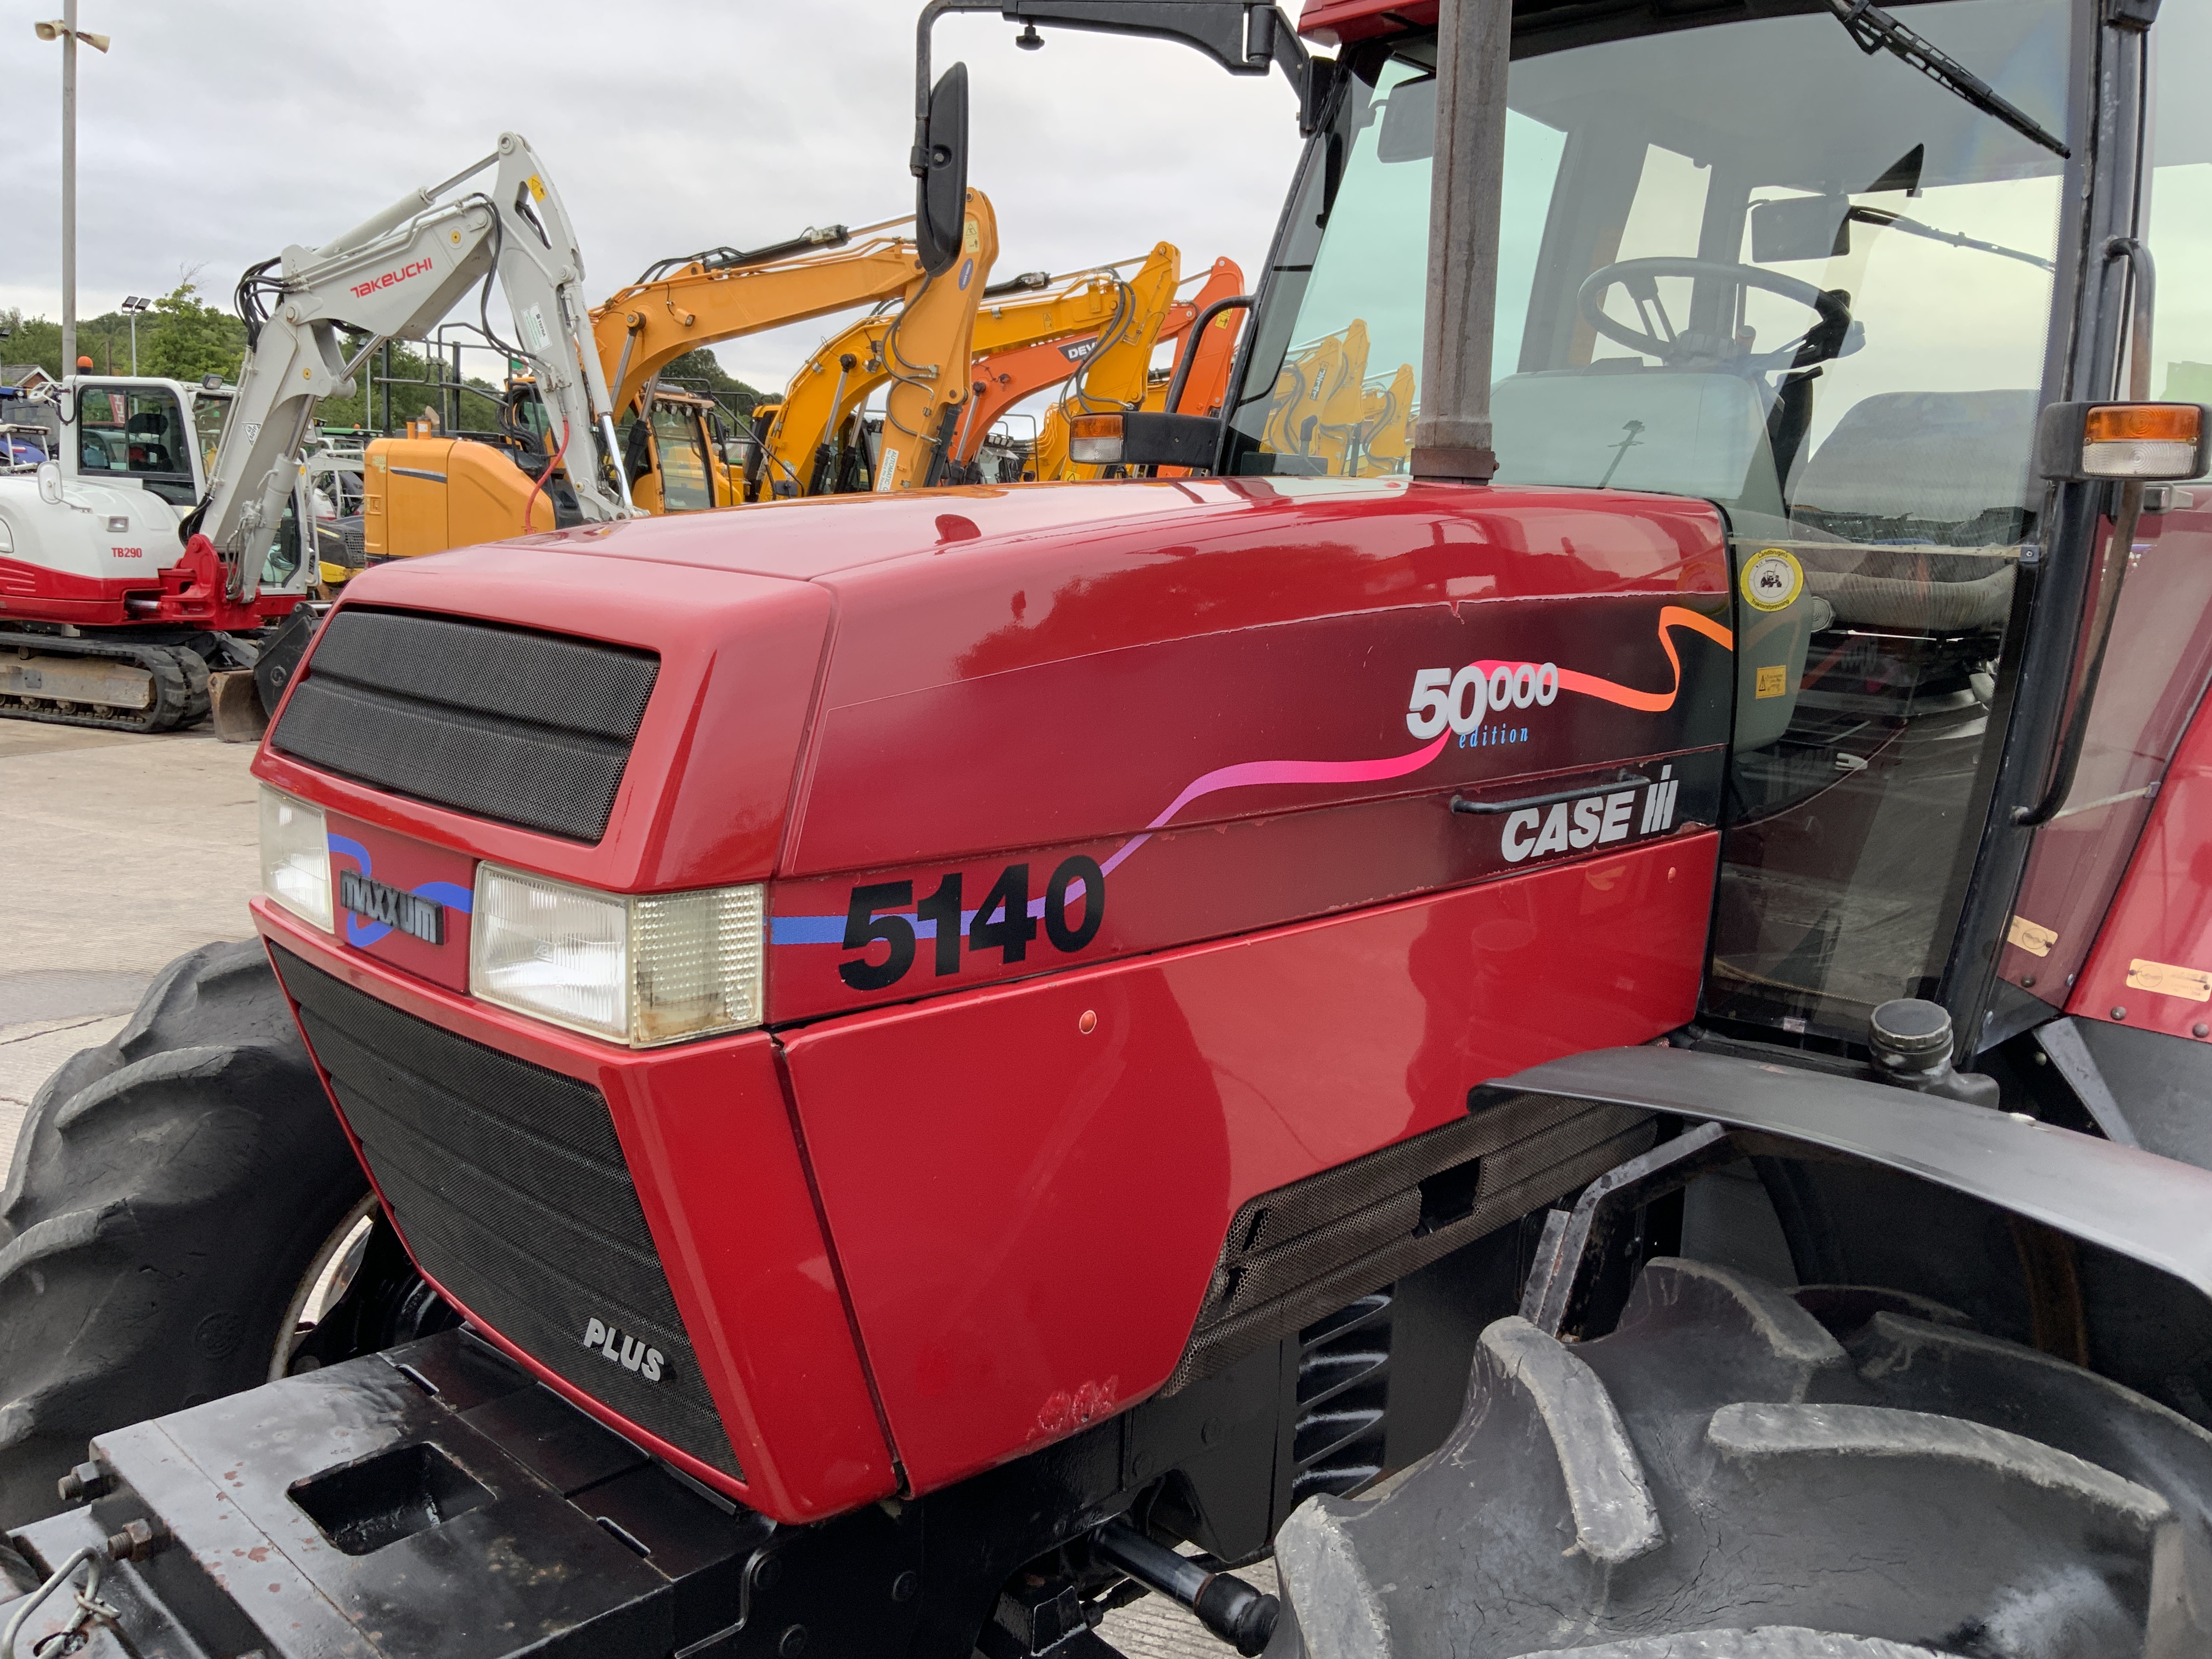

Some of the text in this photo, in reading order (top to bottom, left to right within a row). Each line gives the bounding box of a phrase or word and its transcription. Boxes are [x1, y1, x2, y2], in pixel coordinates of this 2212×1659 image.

[350, 257, 433, 298] TAKEUCHI
[538, 320, 546, 337] TEFRA
[1068, 342, 1097, 359] DEV
[884, 451, 897, 485] AUTOMATIC
[111, 548, 142, 557] TB290
[1406, 662, 1559, 739] 50000
[1459, 724, 1528, 748] edition
[1502, 790, 1635, 862] CASE
[341, 871, 438, 944] MAXXUM
[839, 855, 1105, 991] 5140
[584, 1317, 664, 1381] PLUS
